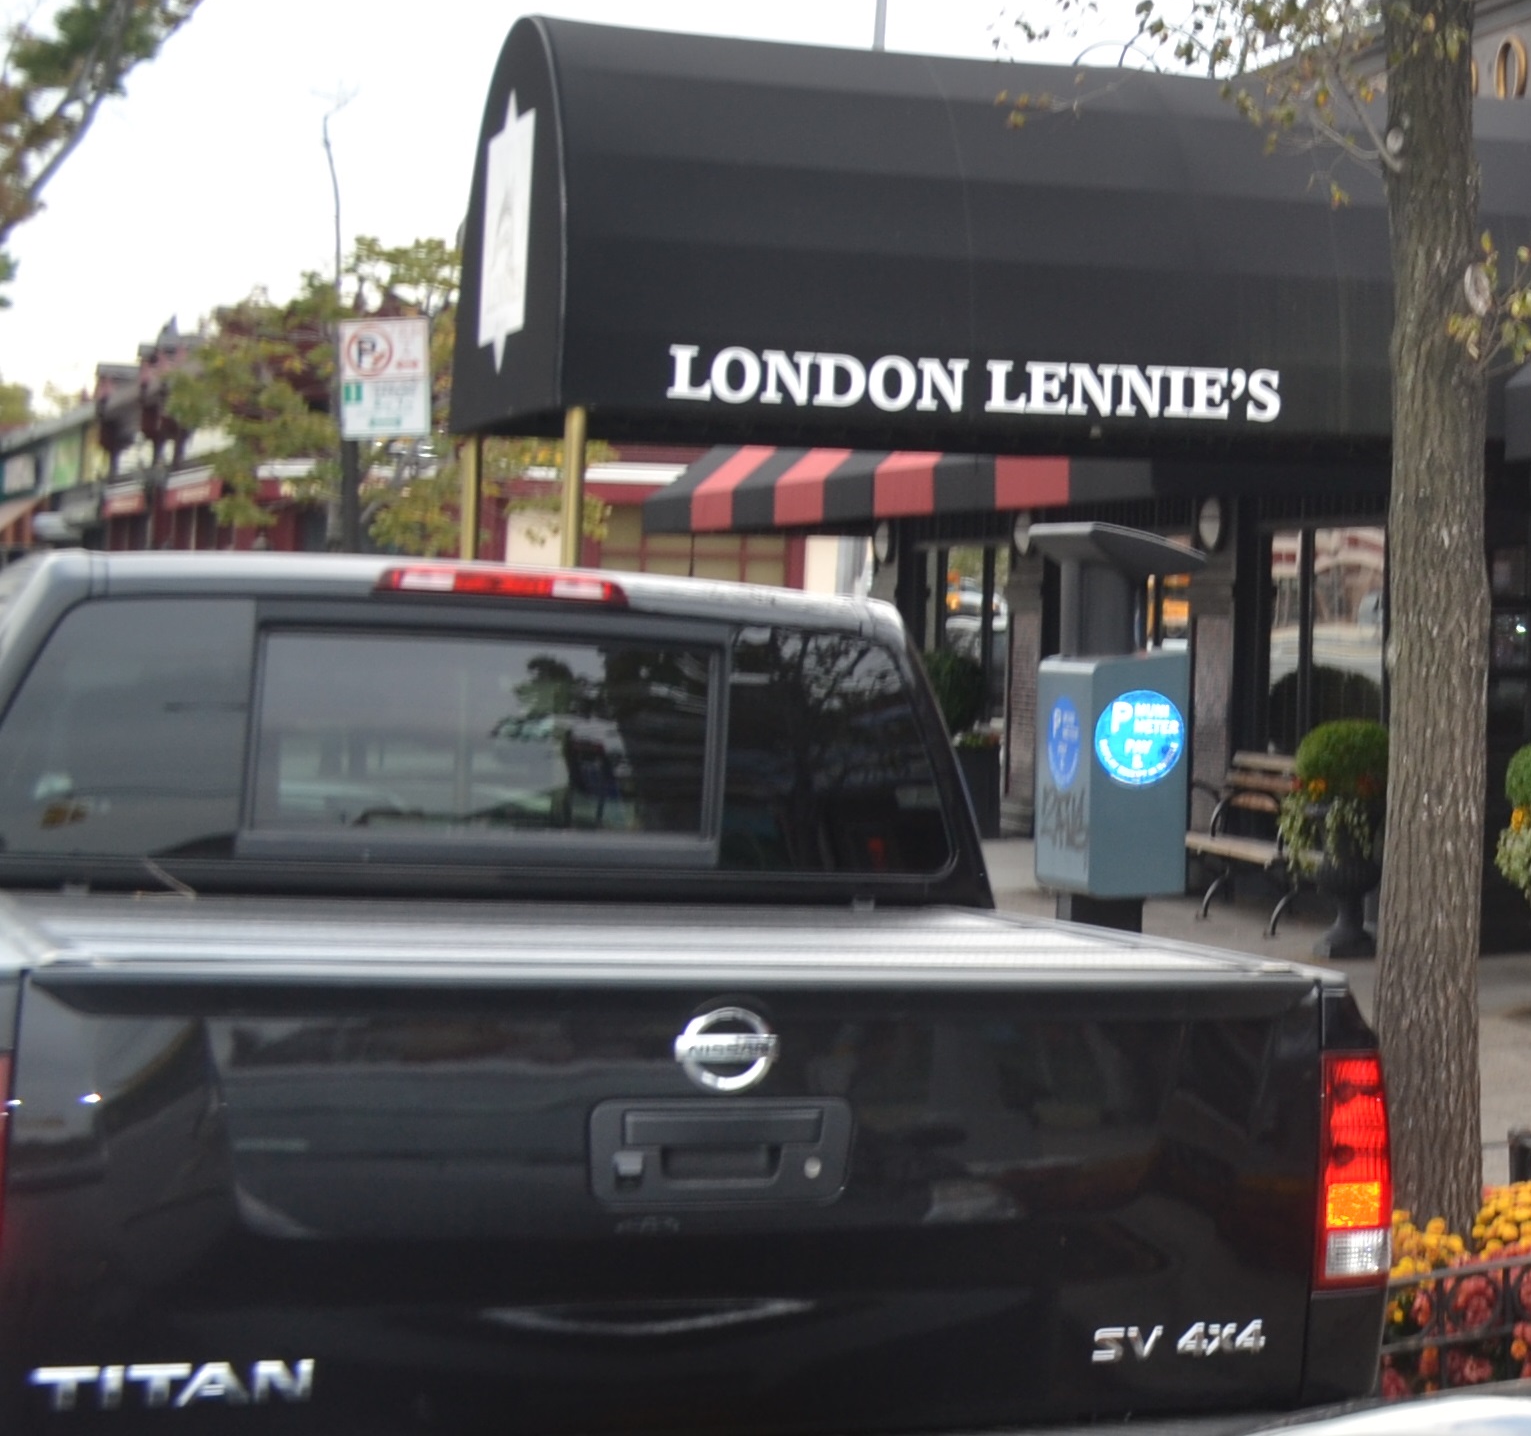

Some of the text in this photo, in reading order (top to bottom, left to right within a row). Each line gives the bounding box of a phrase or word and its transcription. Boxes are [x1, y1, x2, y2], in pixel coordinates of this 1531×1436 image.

[667, 344, 1282, 423] LONDON LENNIE'S
[1134, 718, 1180, 735] METER
[1091, 1324, 1164, 1363] SV
[27, 1358, 315, 1412] TITAN
